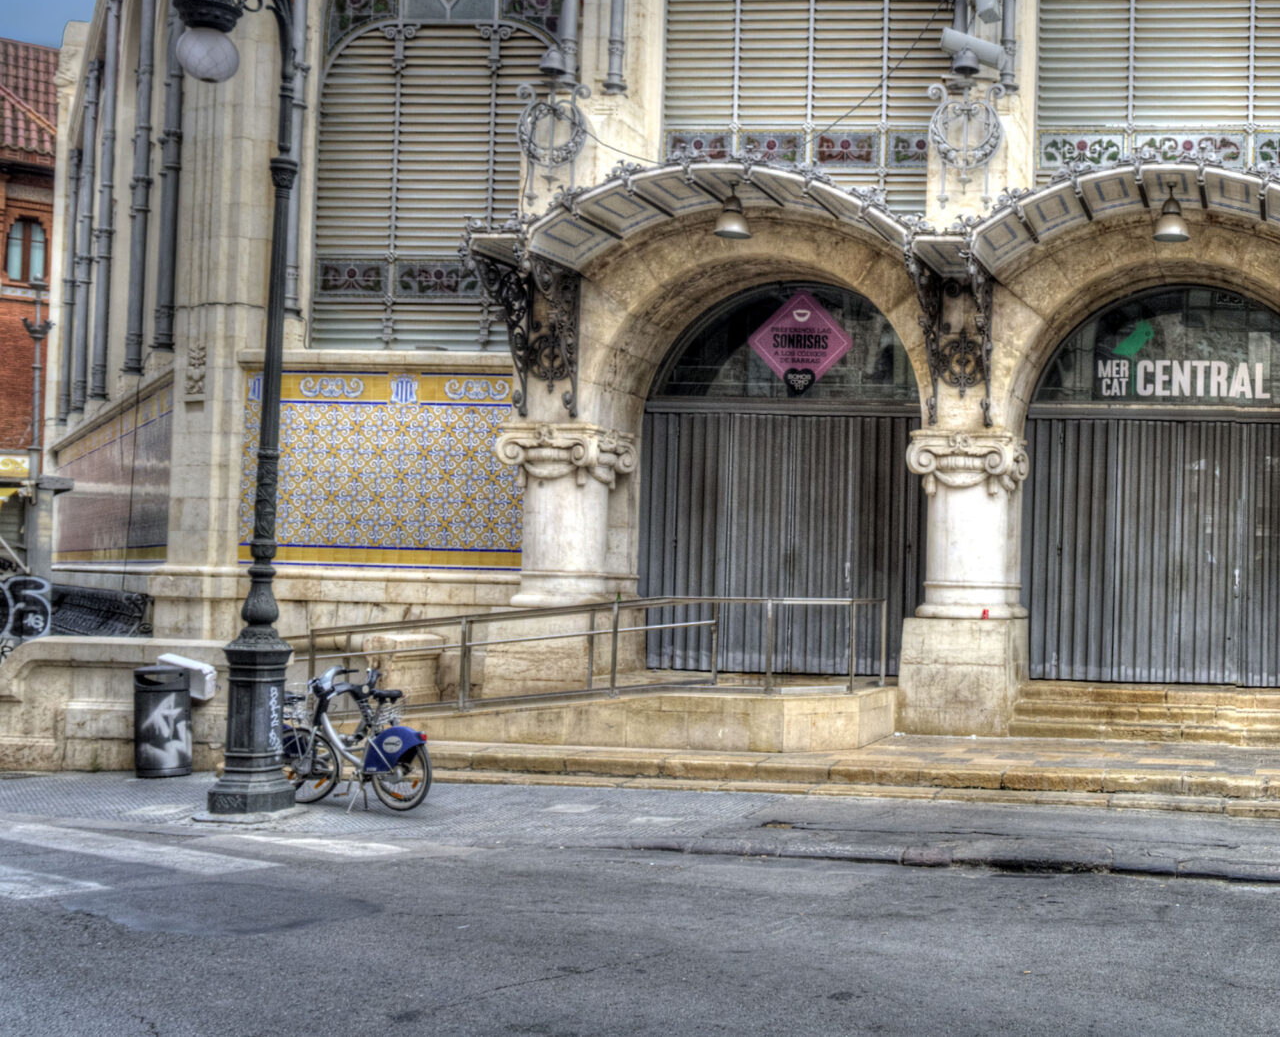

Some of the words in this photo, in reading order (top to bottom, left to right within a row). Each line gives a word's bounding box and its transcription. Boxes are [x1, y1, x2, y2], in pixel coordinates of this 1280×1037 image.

[773, 334, 828, 349] SONRISAS
[1098, 360, 1129, 378] MER
[1102, 378, 1129, 396] CAT
[1136, 360, 1271, 399] CENTRAL
